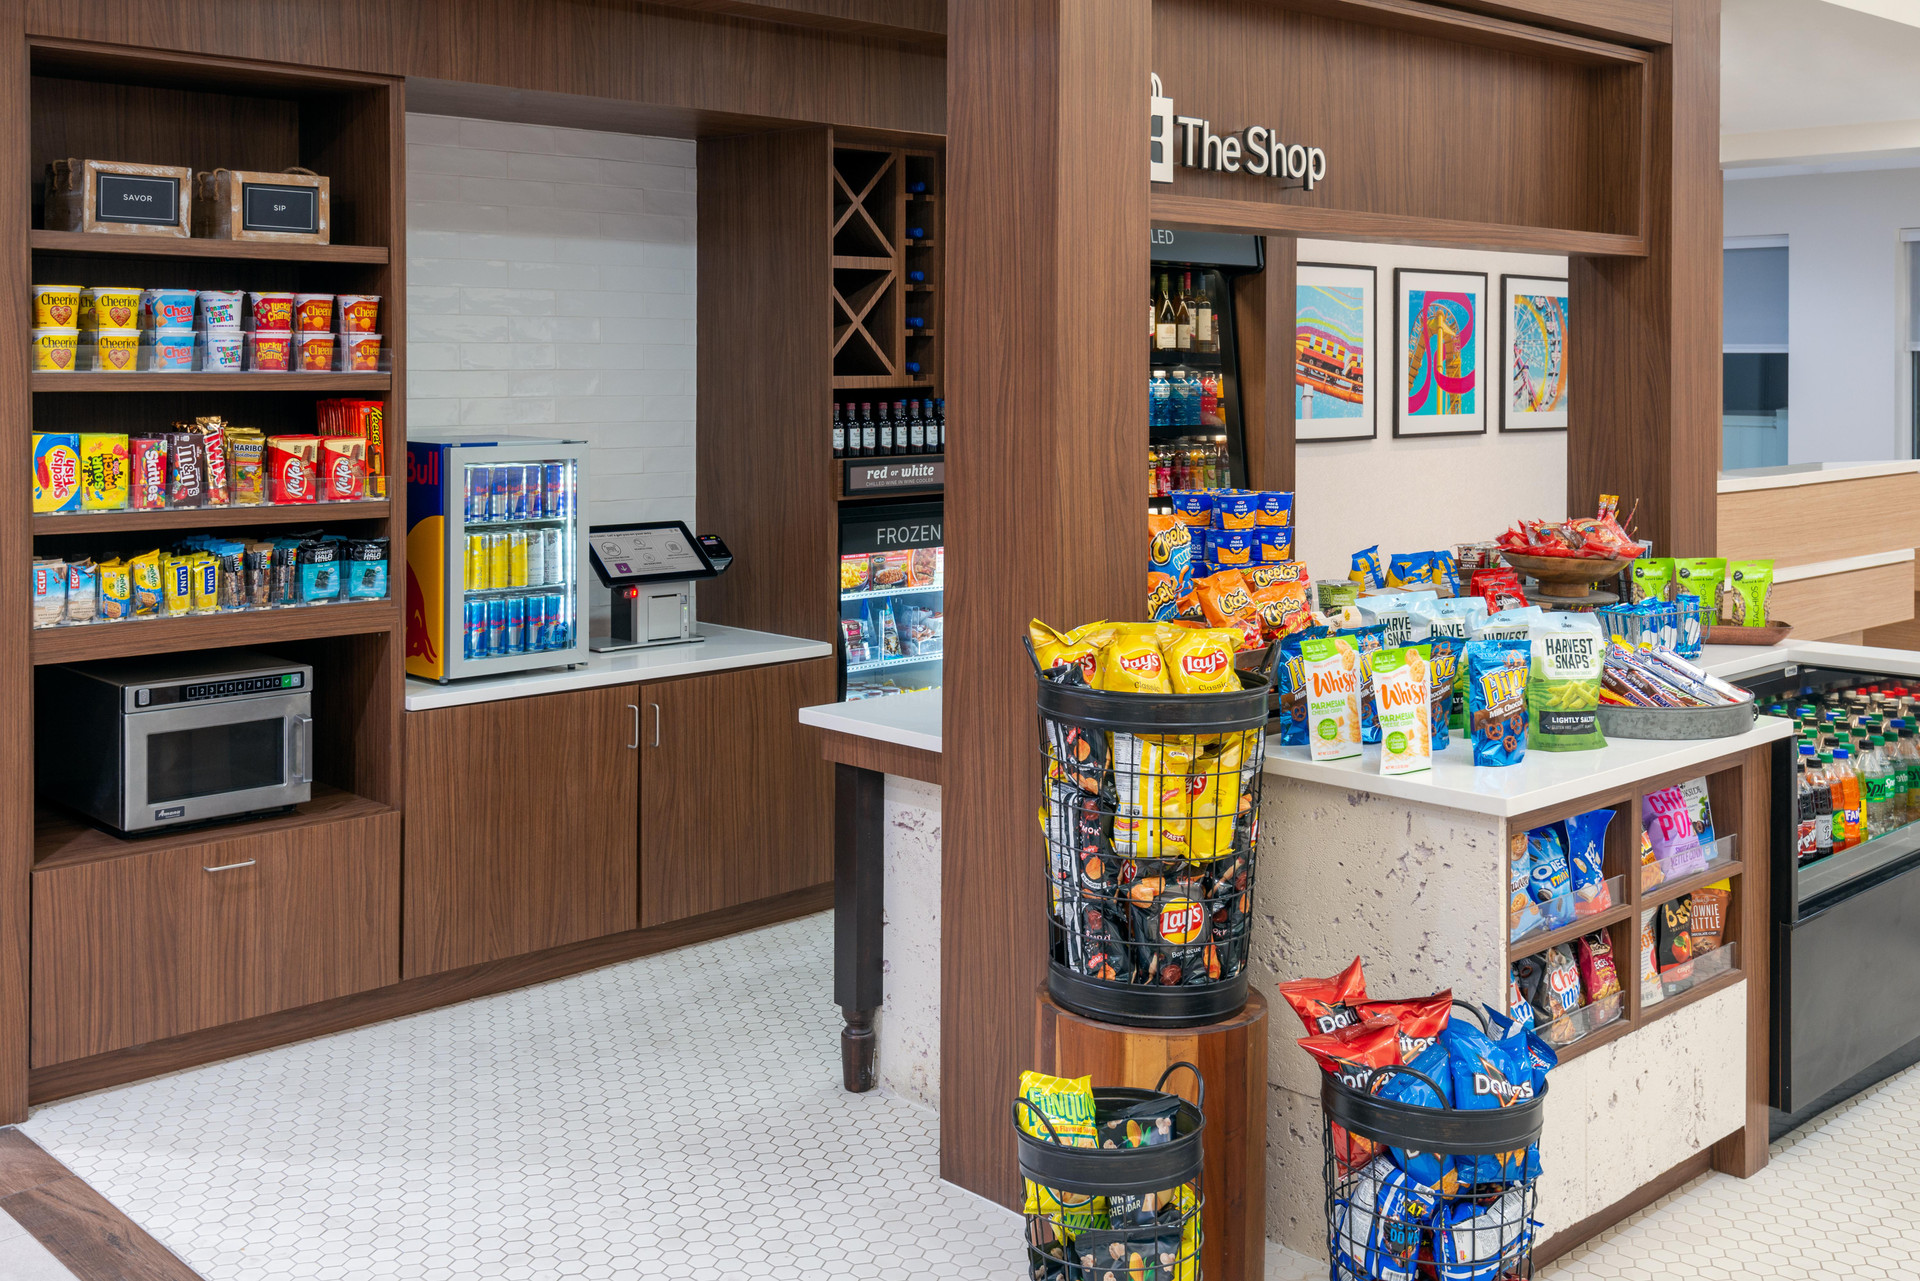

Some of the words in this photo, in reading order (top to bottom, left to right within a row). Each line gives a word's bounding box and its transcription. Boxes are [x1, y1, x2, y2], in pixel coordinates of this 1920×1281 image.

[1174, 116, 1241, 172] The
[1246, 125, 1327, 191] Shop
[122, 193, 153, 203] SAVOR
[272, 203, 287, 212] SIP
[1151, 229, 1174, 245] LED
[41, 293, 78, 306] Cheerios
[101, 295, 137, 307] Cheerios
[163, 305, 192, 318] Chex
[205, 303, 233, 313] Cinnamon
[210, 309, 229, 318] Toast
[271, 301, 291, 313] Lucky
[208, 313, 234, 325] Crunch
[41, 336, 77, 349] Cheerios
[100, 337, 136, 350] Cheerios
[258, 342, 282, 353] Lucky
[163, 346, 191, 358] Chex
[257, 351, 284, 361] Charms
[233, 444, 263, 452] HARIBO
[50, 448, 68, 499] Swedish
[63, 458, 76, 487] Fish
[91, 456, 105, 490] SOUR
[103, 453, 117, 492] PATCH
[407, 451, 439, 486] Bull
[866, 466, 888, 480] red
[890, 469, 899, 477] or
[901, 464, 935, 478] white
[145, 450, 161, 502] Skittles
[877, 524, 942, 545] FROZEN
[1150, 523, 1191, 565] Cheetos
[232, 553, 241, 572] KIND
[178, 568, 187, 594] LUNA
[207, 565, 215, 593] LUNA
[1254, 565, 1299, 586] Cheetos
[1750, 585, 1760, 627] STACHIOS
[1379, 616, 1411, 632] HARVE
[1430, 624, 1464, 638] HARVE
[1387, 632, 1411, 646] SNAP
[1545, 638, 1593, 656] HARVEST
[1186, 650, 1225, 674] Lay's
[1555, 654, 1590, 669] SNAPS
[1134, 680, 1161, 692] Classic
[1198, 682, 1229, 692] Classic
[1307, 668, 1358, 698] Whisps
[1481, 667, 1528, 709] Flipz
[1311, 699, 1346, 710] PARMESAN
[1380, 711, 1415, 722] PARMESAN
[1489, 706, 1504, 719] Milk
[1551, 716, 1580, 724] LIGHTLY
[1165, 831, 1184, 843] TASTY
[1691, 903, 1720, 917] OWNIE
[1162, 906, 1202, 934] Lay's
[1551, 967, 1579, 992] Chex
[1027, 1087, 1096, 1126] FUNYUN
[1109, 1194, 1136, 1206] WHTE
